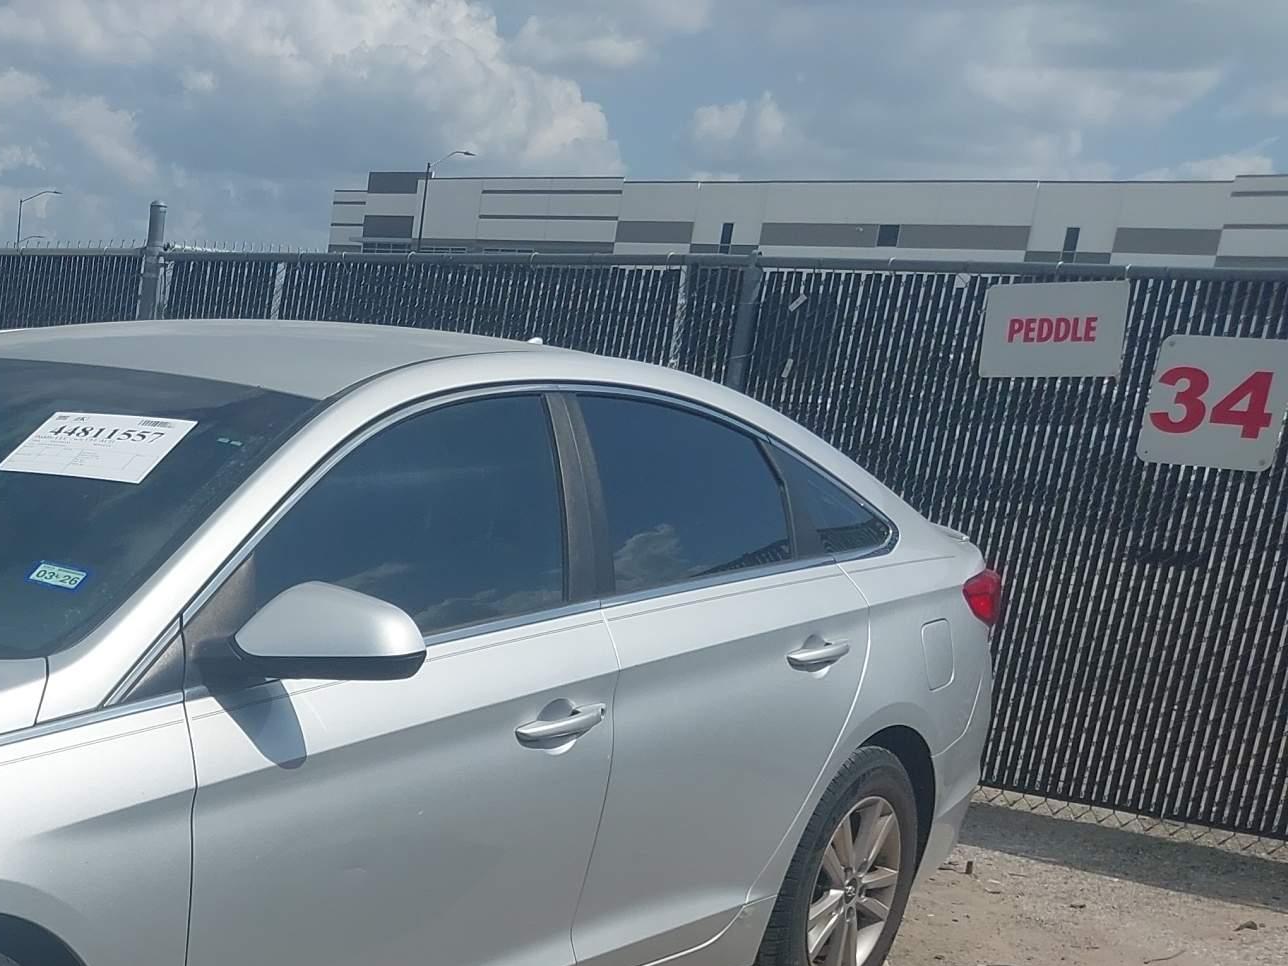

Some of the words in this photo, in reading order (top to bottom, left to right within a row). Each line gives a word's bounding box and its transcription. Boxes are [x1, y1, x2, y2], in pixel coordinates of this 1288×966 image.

[1007, 316, 1098, 343] PEDDLE
[1149, 366, 1274, 439] 34
[48, 424, 165, 444] 44811557
